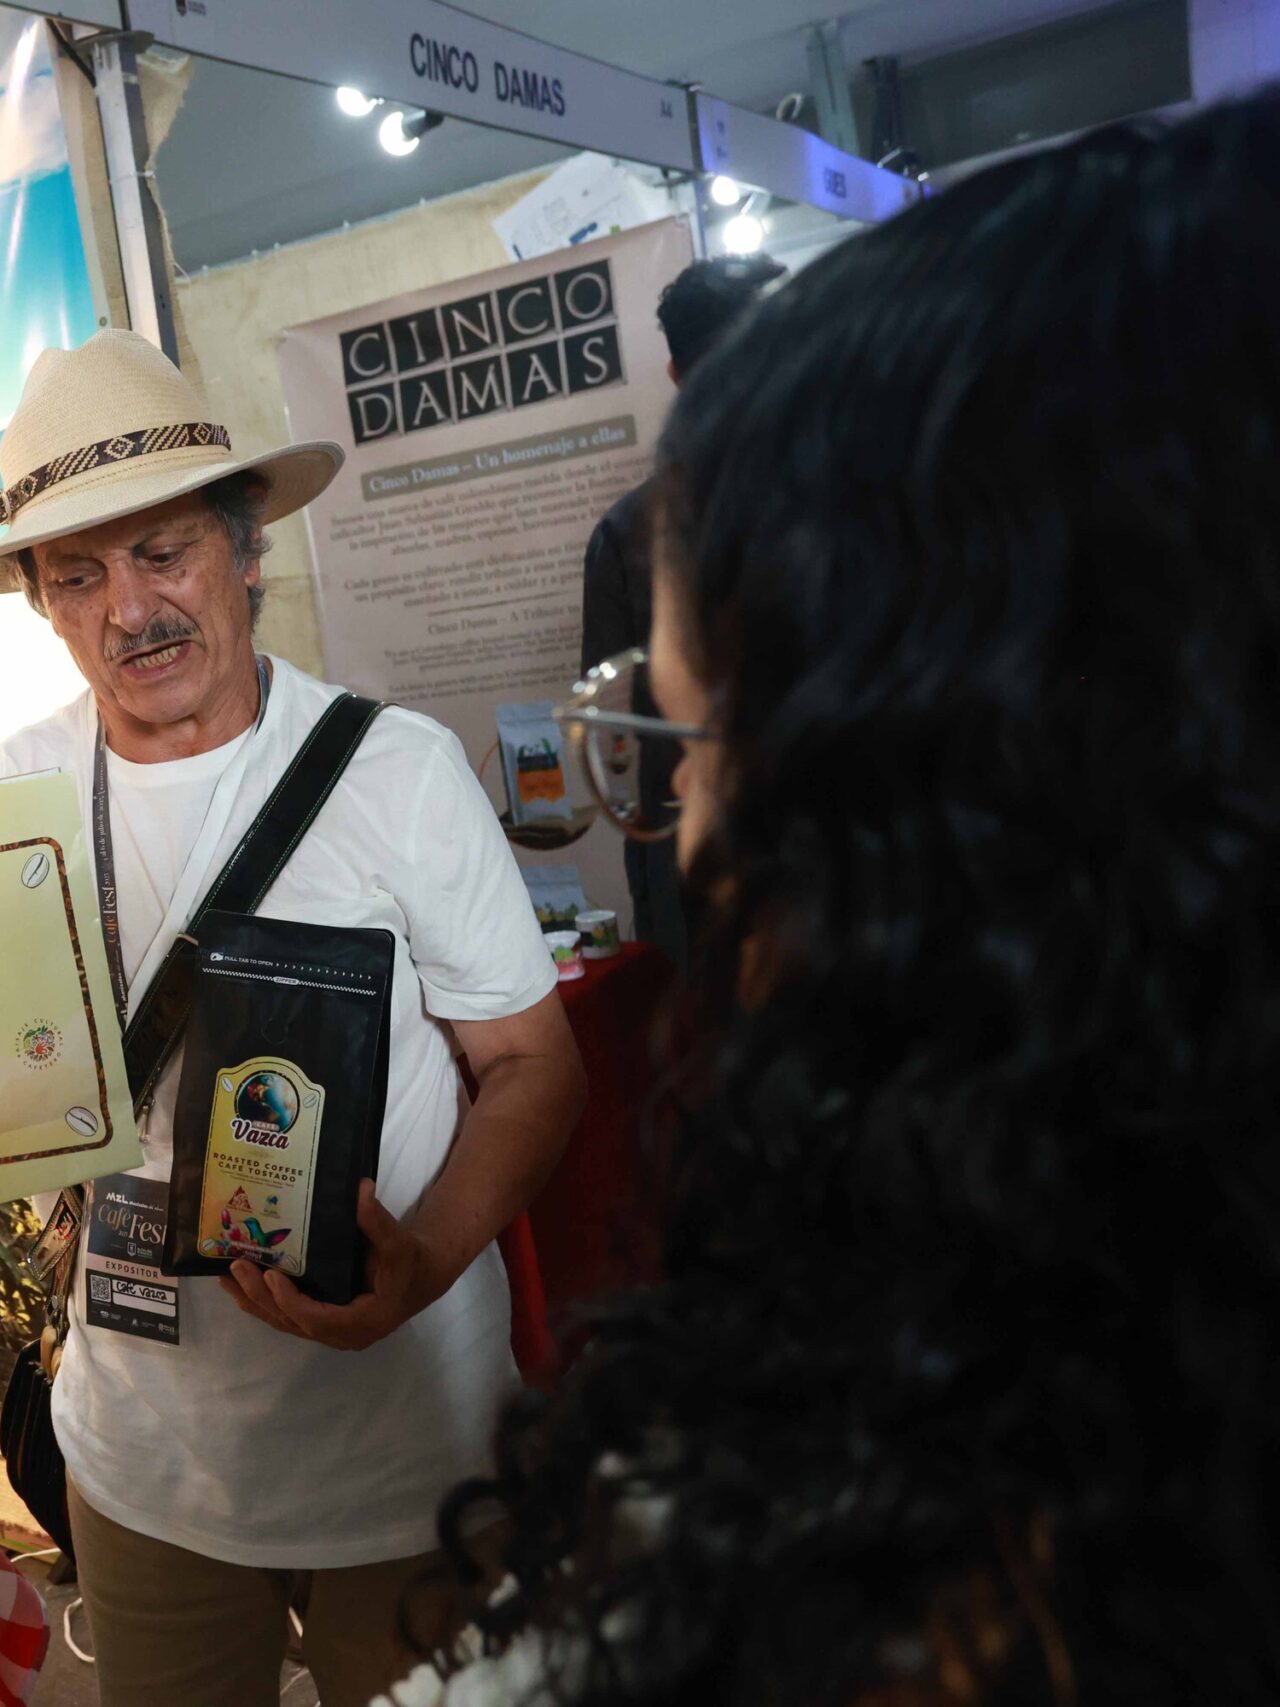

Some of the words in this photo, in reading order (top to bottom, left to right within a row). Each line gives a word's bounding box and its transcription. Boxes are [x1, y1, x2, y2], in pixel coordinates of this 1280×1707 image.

[410, 33, 479, 93] CINCO
[494, 60, 565, 117] DAMAS
[349, 271, 607, 377] CINCO
[356, 336, 608, 437] DAMAS
[369, 473, 409, 494] Cinco
[412, 463, 460, 484] Damas
[475, 453, 499, 471] Un
[503, 437, 575, 465] homenaje
[579, 437, 588, 448] a
[591, 427, 626, 446] ellas
[102, 886, 116, 914] Fest
[230, 1118, 291, 1150] Vazca
[213, 1152, 260, 1167] ROASTED
[264, 1163, 304, 1176] COFFEE
[249, 1168, 296, 1182] TOSTADO
[106, 1192, 128, 1204] MZL
[106, 1261, 159, 1279] EXPOSITOR
